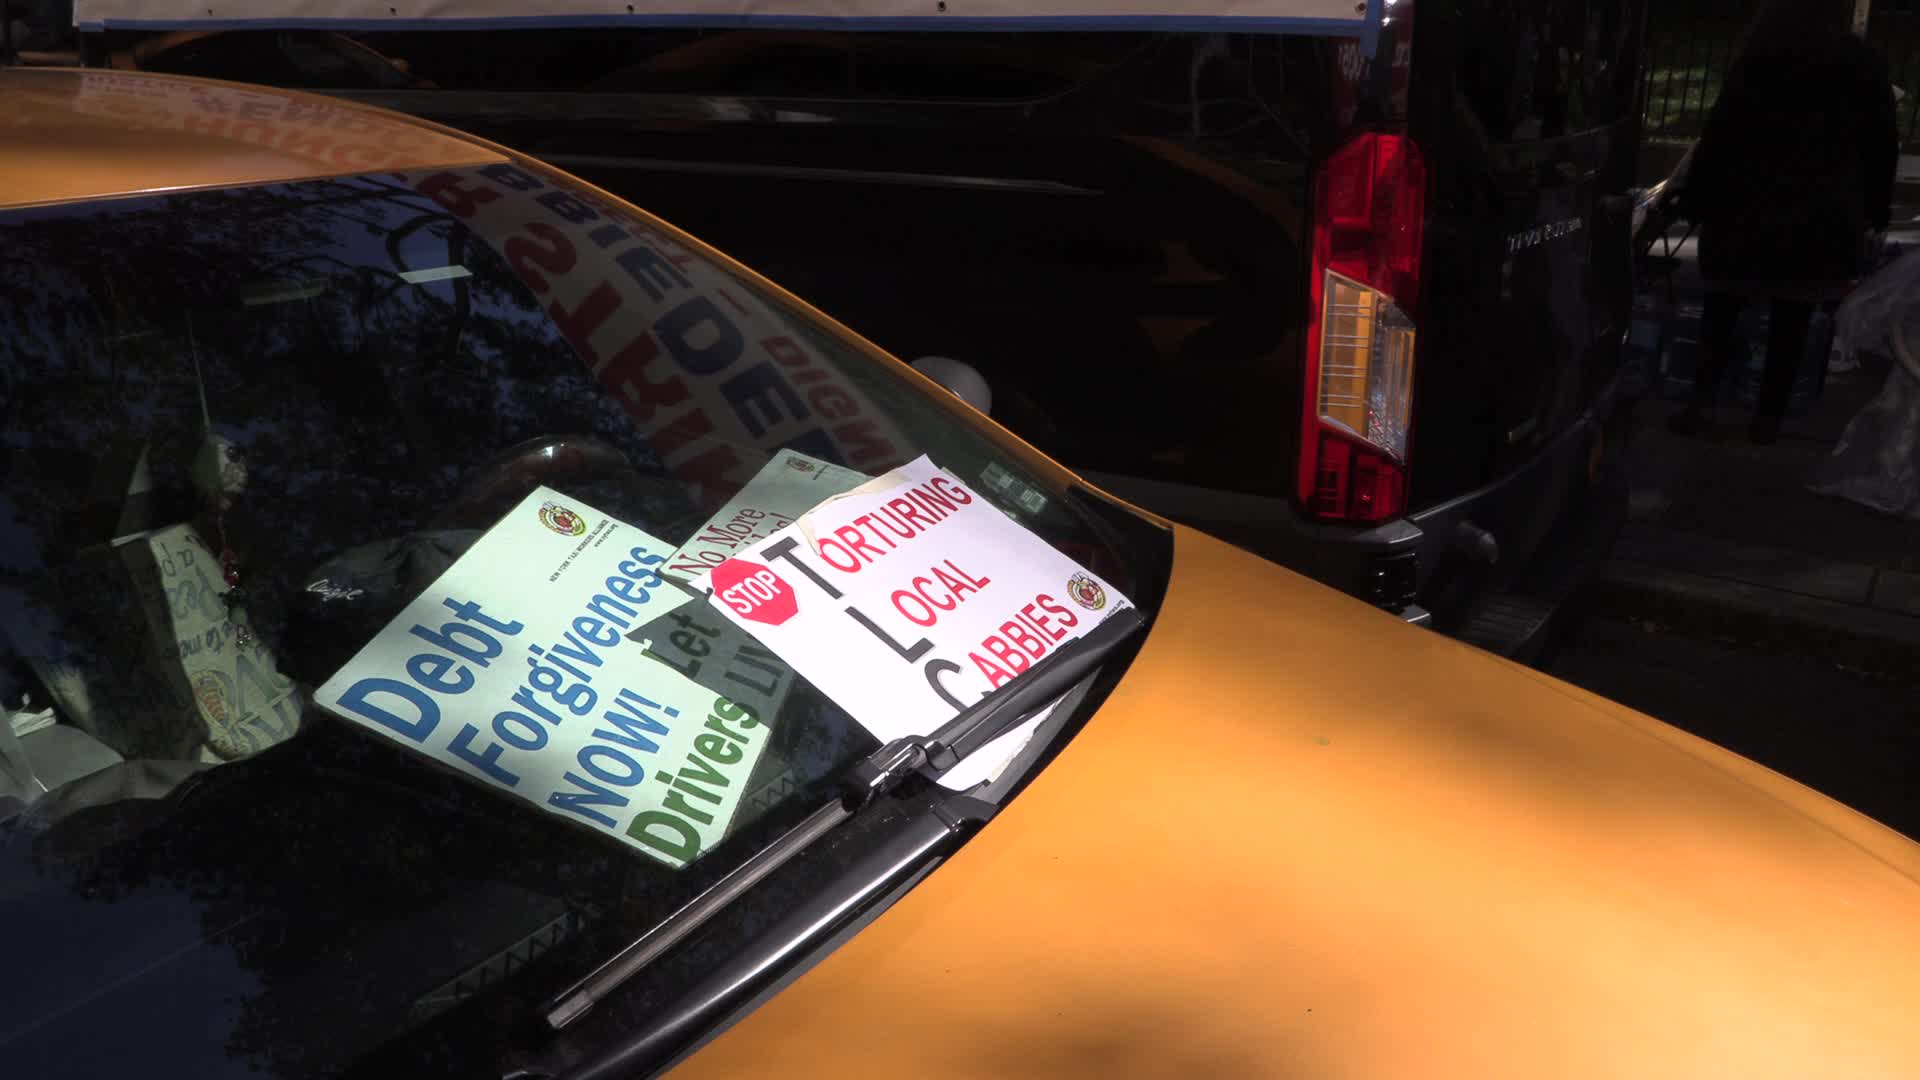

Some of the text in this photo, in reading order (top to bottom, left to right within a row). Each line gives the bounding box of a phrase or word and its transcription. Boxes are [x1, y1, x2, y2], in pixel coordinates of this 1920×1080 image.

[669, 550, 726, 576] No
[697, 508, 765, 549] More
[721, 569, 782, 614] STOP
[844, 558, 991, 664] LOCAL
[335, 597, 525, 744] Debt
[446, 546, 666, 787] Forgiveness
[641, 611, 722, 680] Let
[547, 687, 680, 829] NOW!
[626, 696, 761, 867] Drivers
